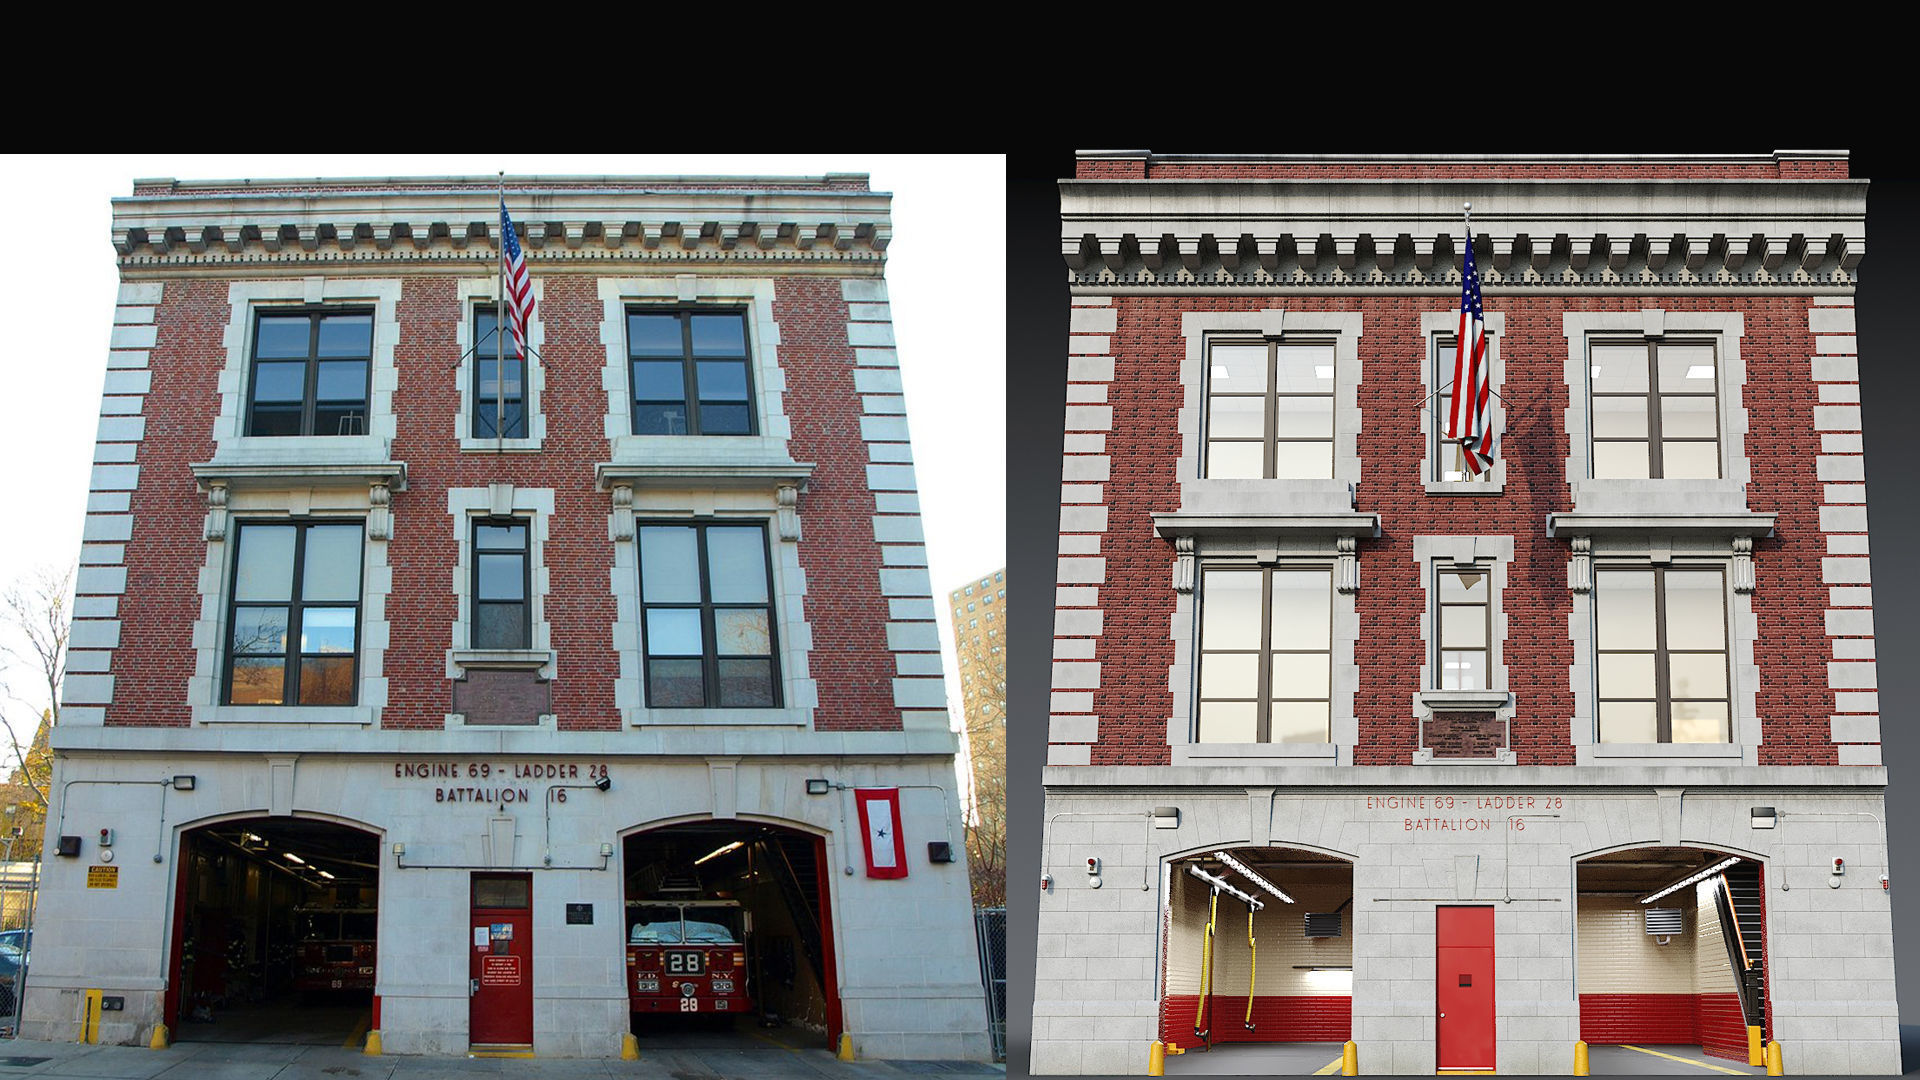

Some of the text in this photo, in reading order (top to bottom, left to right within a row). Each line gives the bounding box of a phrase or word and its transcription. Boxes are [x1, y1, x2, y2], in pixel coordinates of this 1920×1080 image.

[395, 763, 458, 778] ENGINE
[468, 763, 490, 778] 69
[515, 764, 578, 779] LADDER
[589, 765, 609, 778] 28
[435, 788, 567, 803] BATTALION 16
[1367, 796, 1425, 809] ENGINE
[1434, 796, 1455, 809] 69
[1477, 796, 1536, 809] LADDER
[1545, 796, 1563, 809] 28
[1404, 818, 1526, 831] BATTALION 16
[671, 954, 699, 972] 28
[680, 998, 698, 1012] 28
